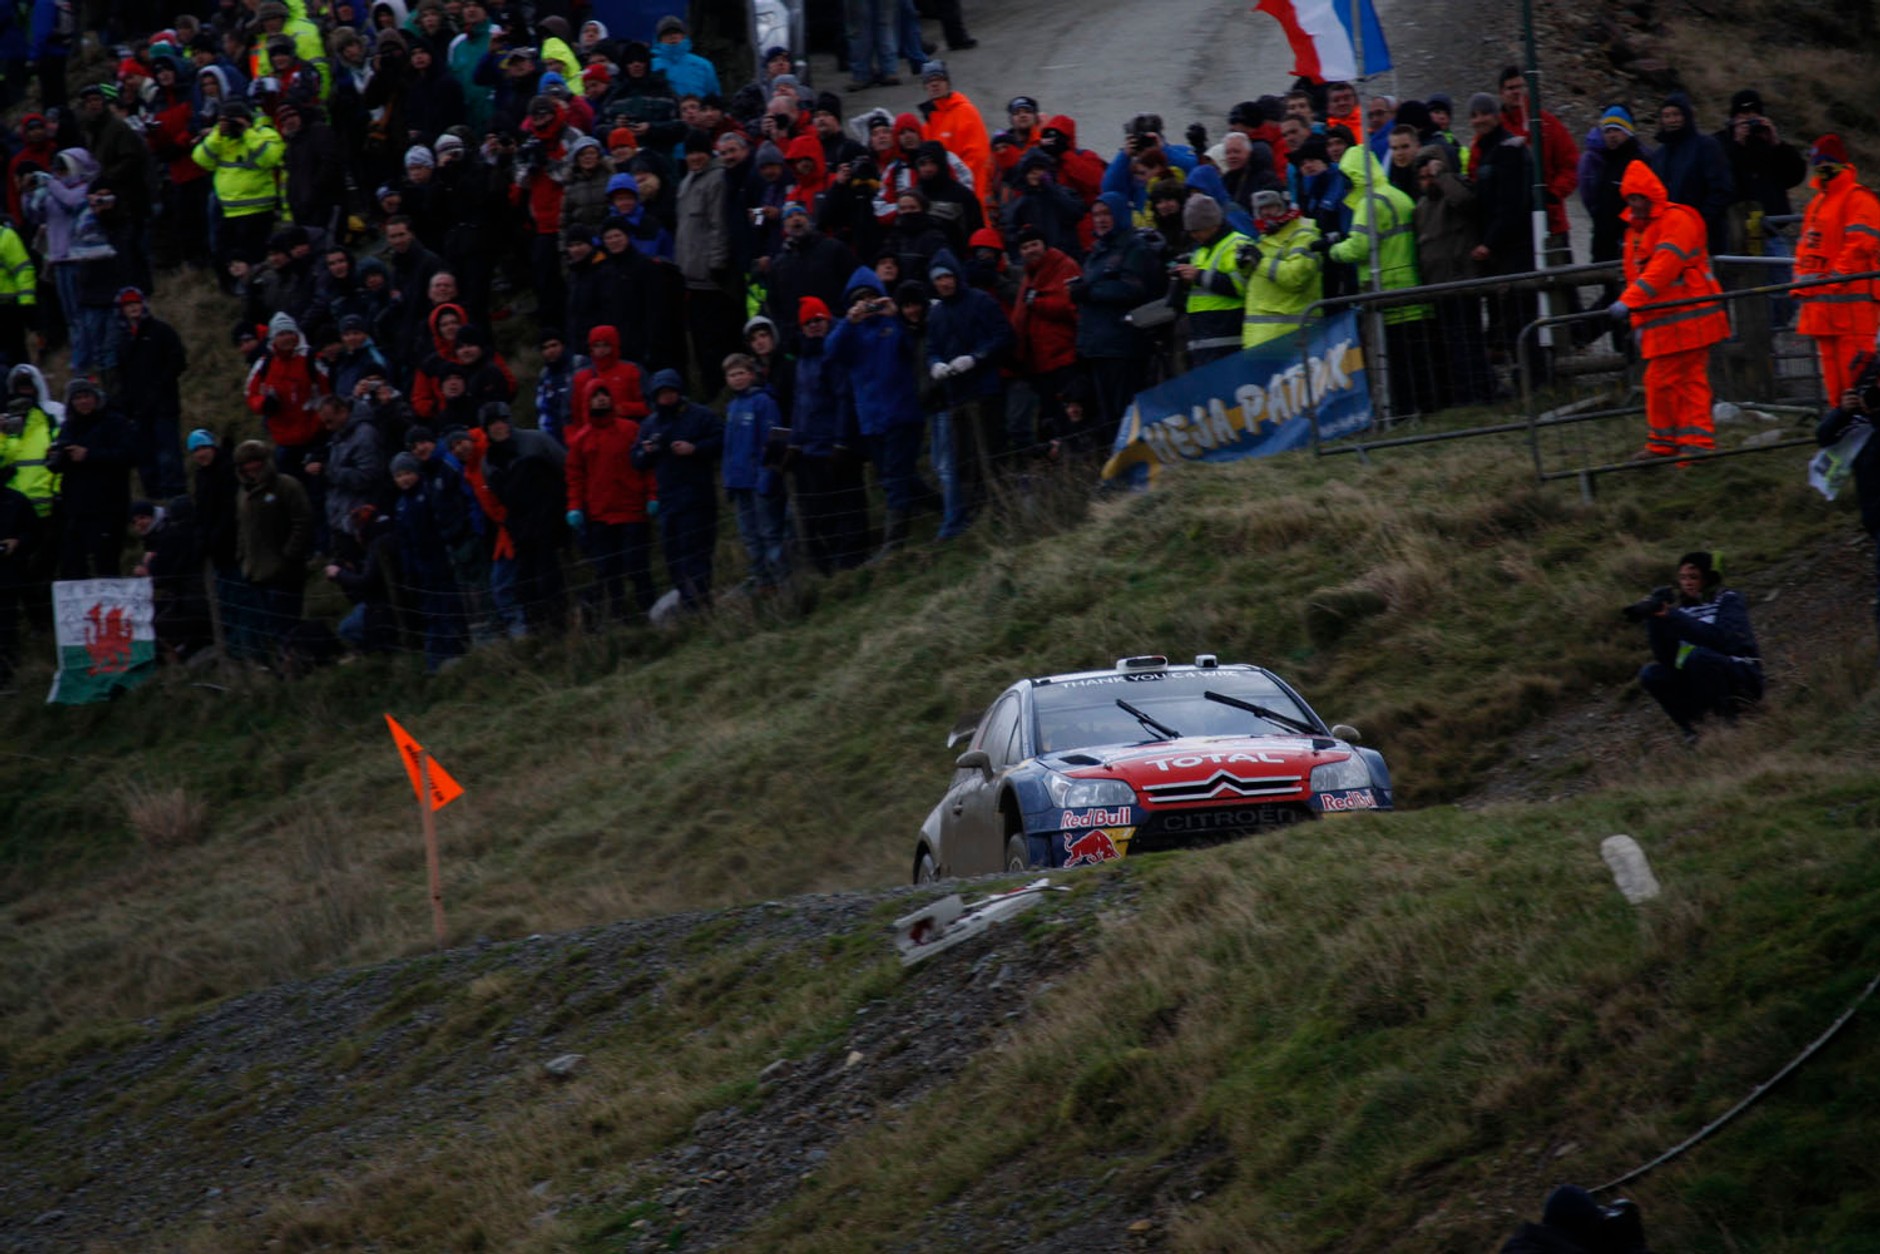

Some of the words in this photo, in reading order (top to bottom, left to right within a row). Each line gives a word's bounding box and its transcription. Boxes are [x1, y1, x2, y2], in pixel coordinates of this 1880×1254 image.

[1141, 397, 1241, 464] HEJA
[1063, 674, 1126, 689] THANK
[1129, 671, 1166, 682] YOU
[1146, 752, 1284, 771] TOTAL
[1320, 791, 1353, 810] Red
[1060, 807, 1093, 830] Red
[1091, 805, 1131, 828] Bull
[1163, 804, 1297, 831] CITROËN
